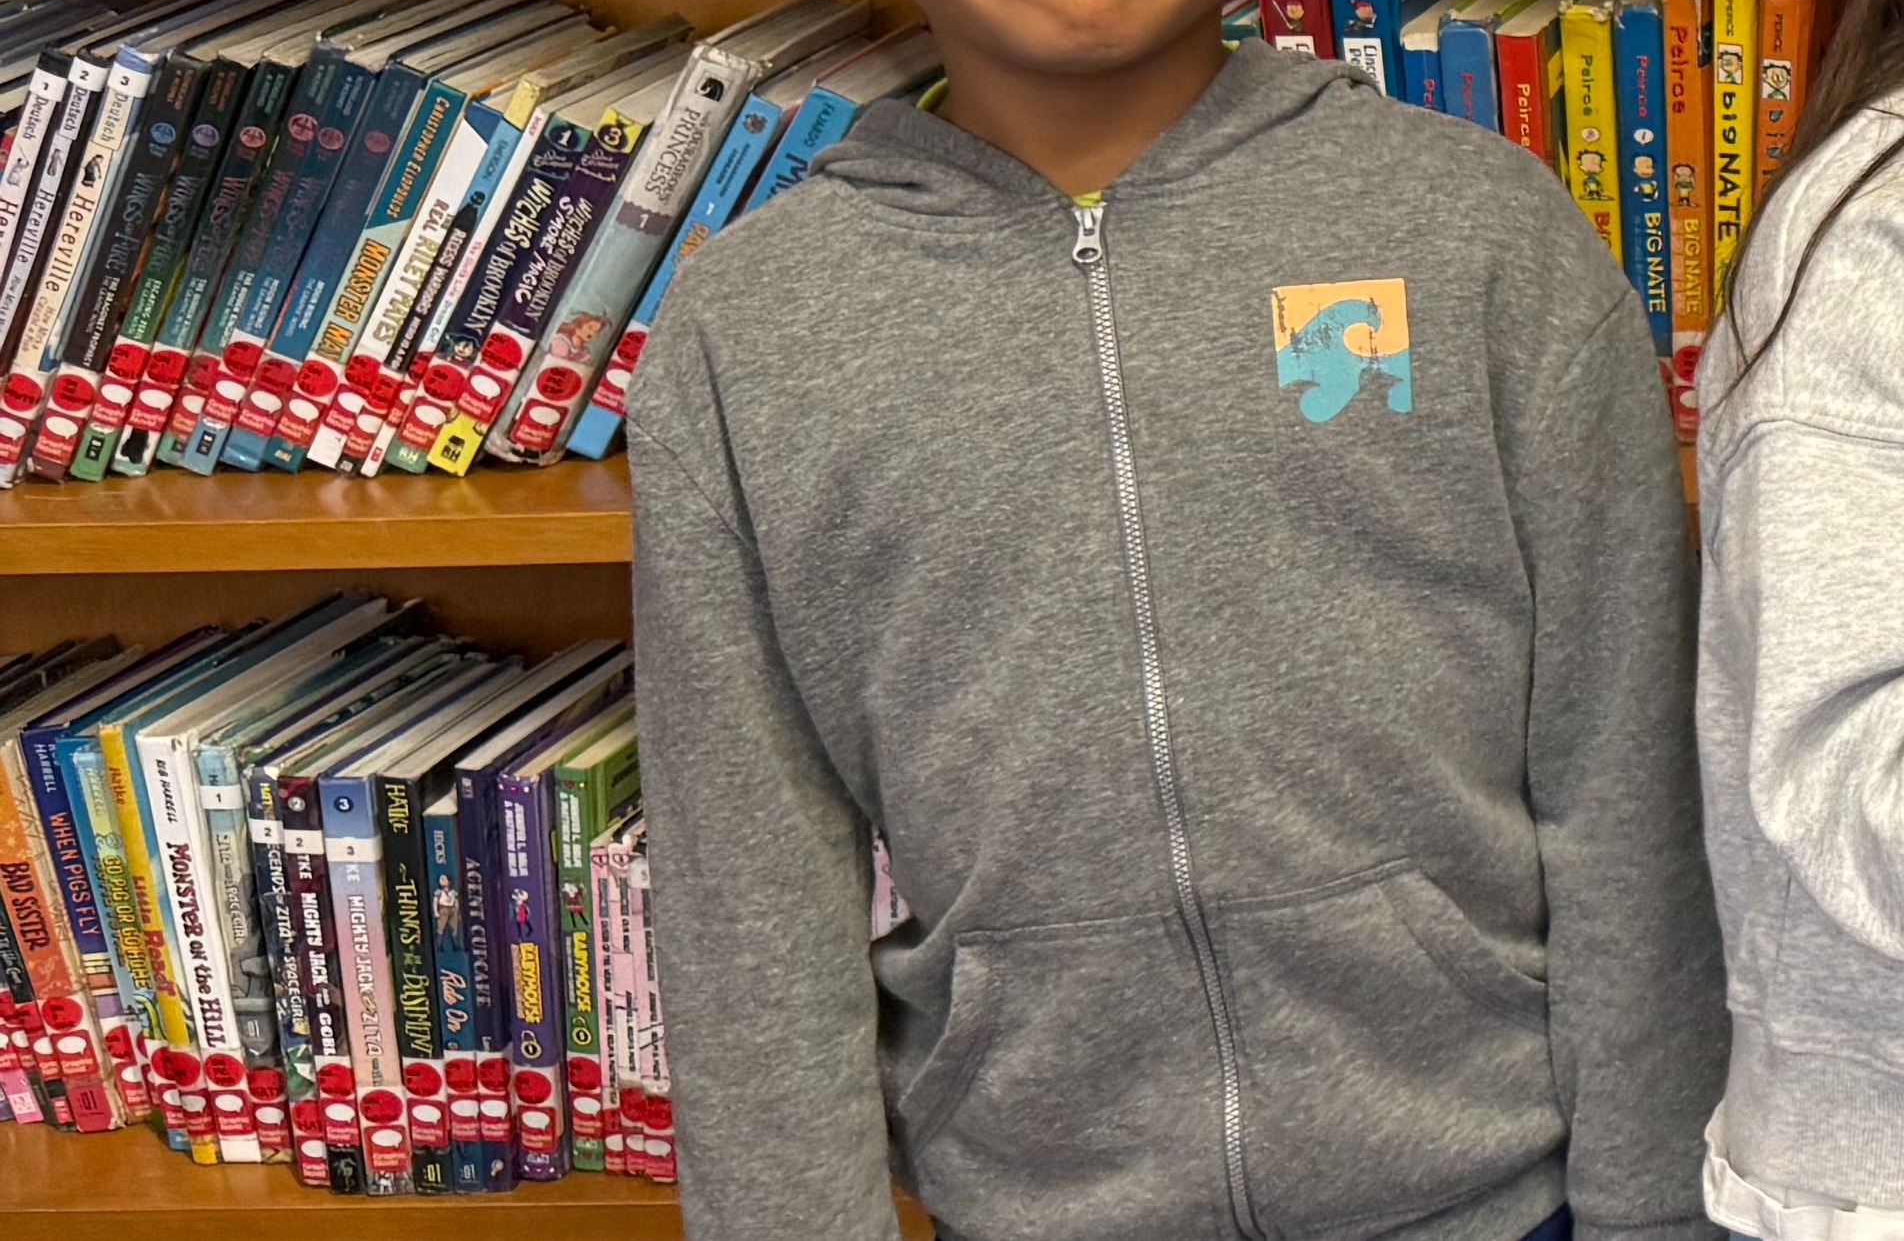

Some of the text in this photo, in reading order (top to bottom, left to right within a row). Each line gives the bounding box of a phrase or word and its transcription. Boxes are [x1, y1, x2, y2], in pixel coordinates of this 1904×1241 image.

[62, 85, 89, 132] Deutsch
[1580, 54, 1594, 118] Peirce
[1670, 25, 1689, 114] Peirce
[102, 89, 129, 143] Deutsch
[644, 106, 702, 196] PRINCESS
[1517, 83, 1532, 148] Peirce
[17, 187, 56, 265] Hereville
[1717, 152, 1741, 242] NATE
[45, 194, 97, 294] Hereville
[334, 238, 392, 324] MONSTER
[402, 198, 450, 286] REAL RILEY
[463, 178, 554, 337] WITCHES BROOKLYN
[515, 250, 547, 305] MAGIC
[1646, 266, 1667, 313] NATE
[1, 861, 51, 951] BAD SISTER
[49, 811, 102, 938] WHEN PIGS FLY
[394, 879, 423, 947] THINGS
[145, 928, 177, 996] Robot
[166, 841, 229, 1050] MONSTER the HILL
[300, 891, 338, 1057] MIGHTY JACK GOBL
[345, 894, 375, 996] MIGHTY JACK
[464, 857, 492, 1009] AGENT CUPCAKE
[573, 931, 592, 1014] BABYMOUSE
[519, 941, 541, 1025] BABYMOUSE
